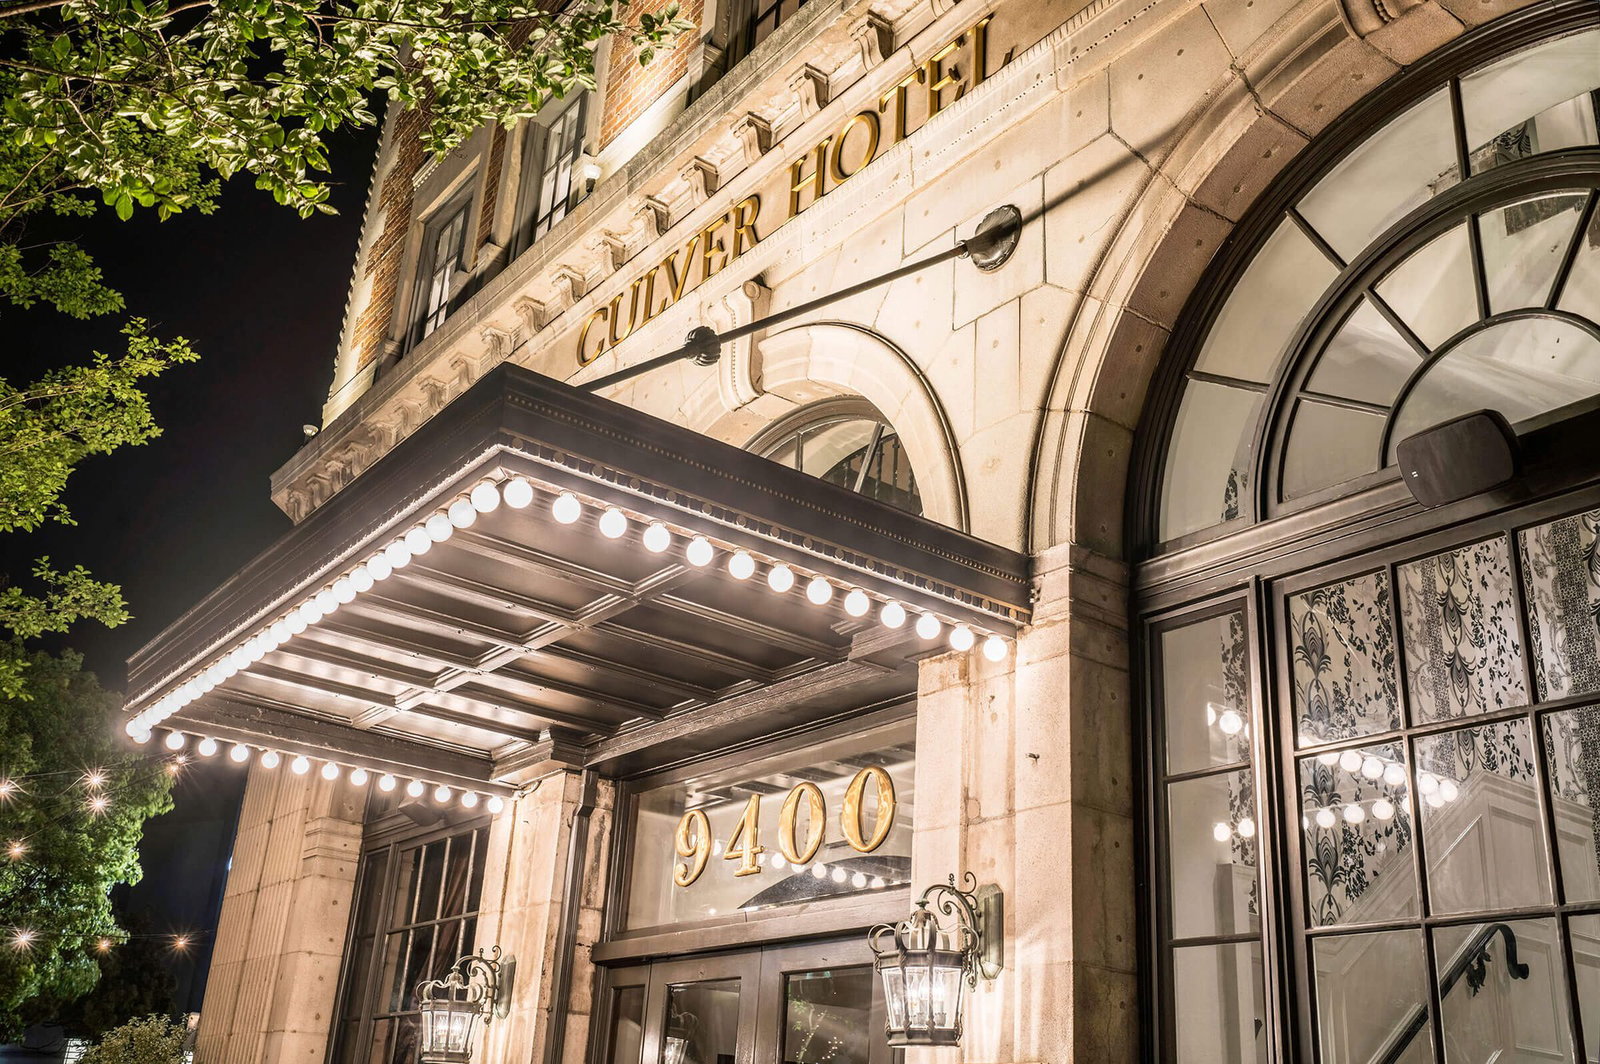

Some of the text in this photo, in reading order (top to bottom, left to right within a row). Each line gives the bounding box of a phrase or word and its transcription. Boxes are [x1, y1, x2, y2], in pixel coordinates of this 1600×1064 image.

[576, 16, 1013, 367] CULVER HOTEL
[674, 766, 896, 887] 9400
